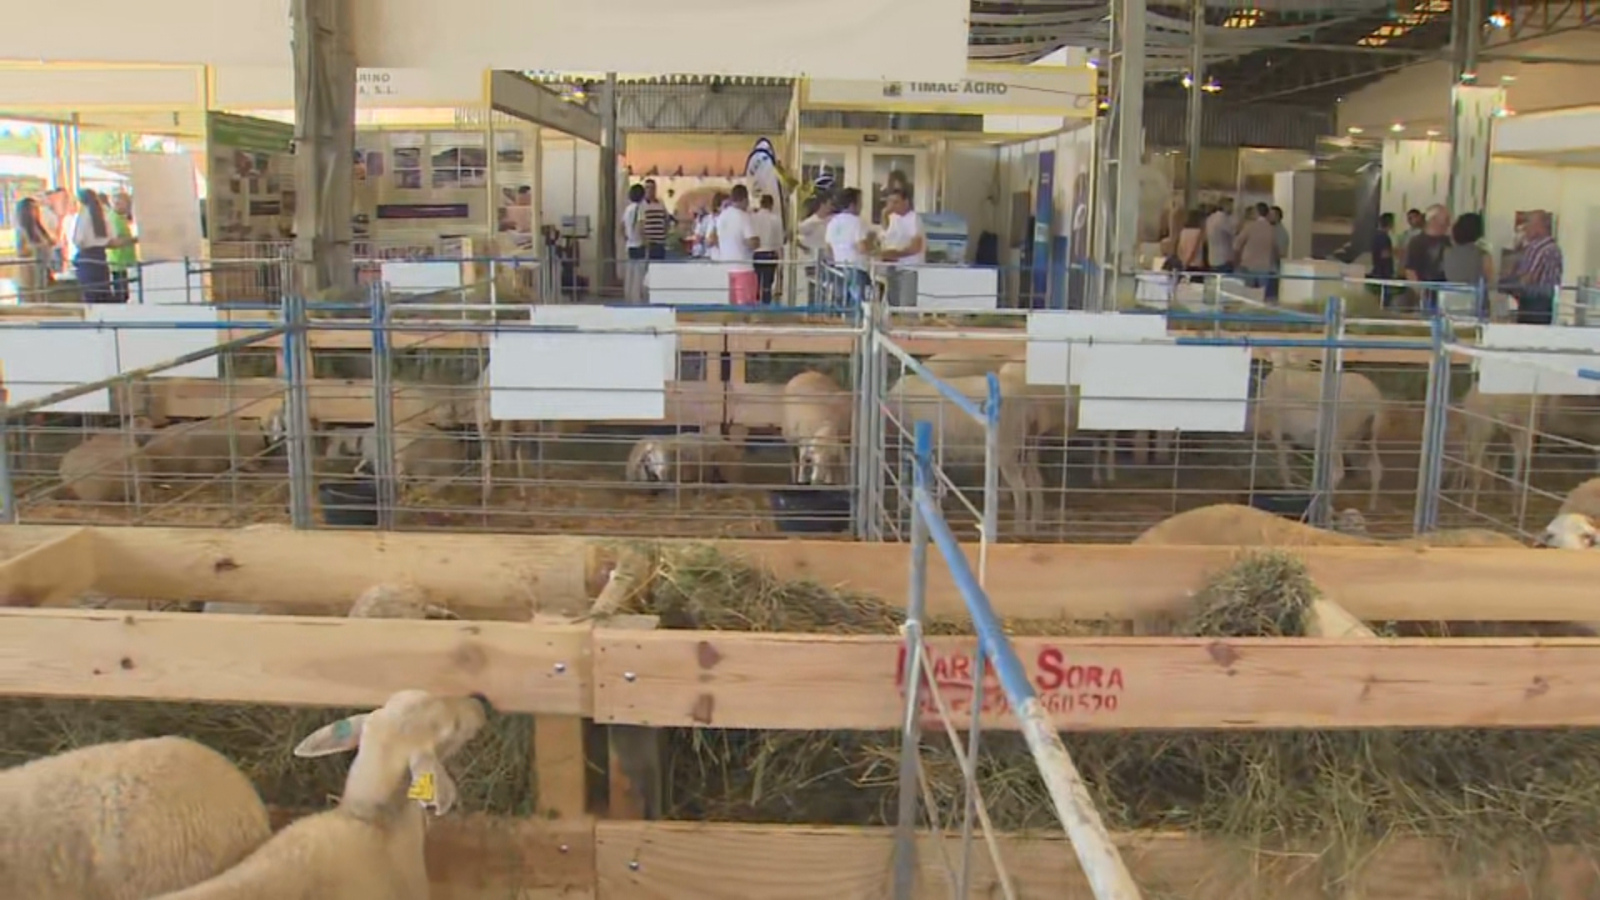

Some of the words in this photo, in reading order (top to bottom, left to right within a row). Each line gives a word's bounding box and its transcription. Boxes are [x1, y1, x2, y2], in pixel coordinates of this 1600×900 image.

[358, 73, 391, 82] RINO
[963, 81, 1008, 95] AGRO
[1036, 647, 1124, 691] SORA
